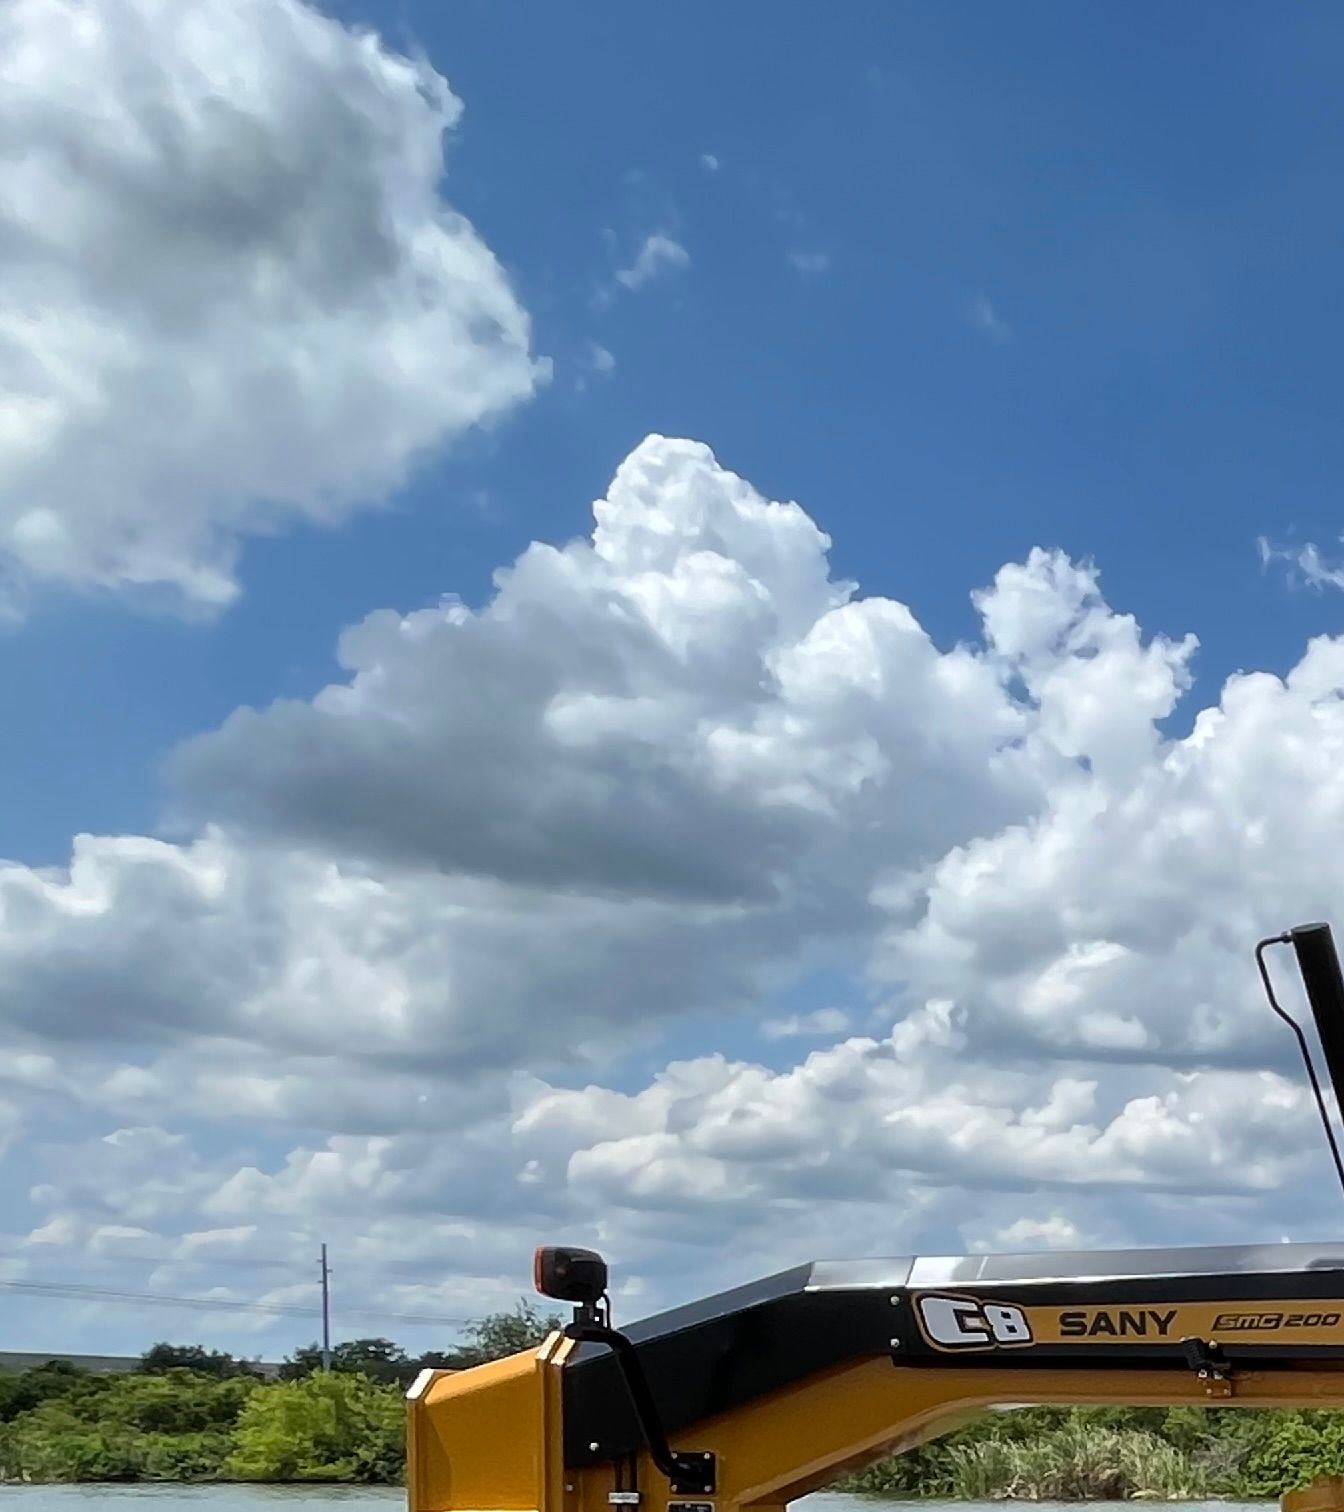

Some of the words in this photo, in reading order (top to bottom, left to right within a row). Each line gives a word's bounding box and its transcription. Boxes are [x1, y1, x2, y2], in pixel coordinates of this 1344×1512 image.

[920, 1297, 1031, 1345] C8
[1059, 1310, 1178, 1336] SANY
[1213, 1313, 1283, 1331] SMG
[1285, 1313, 1342, 1327] 200
